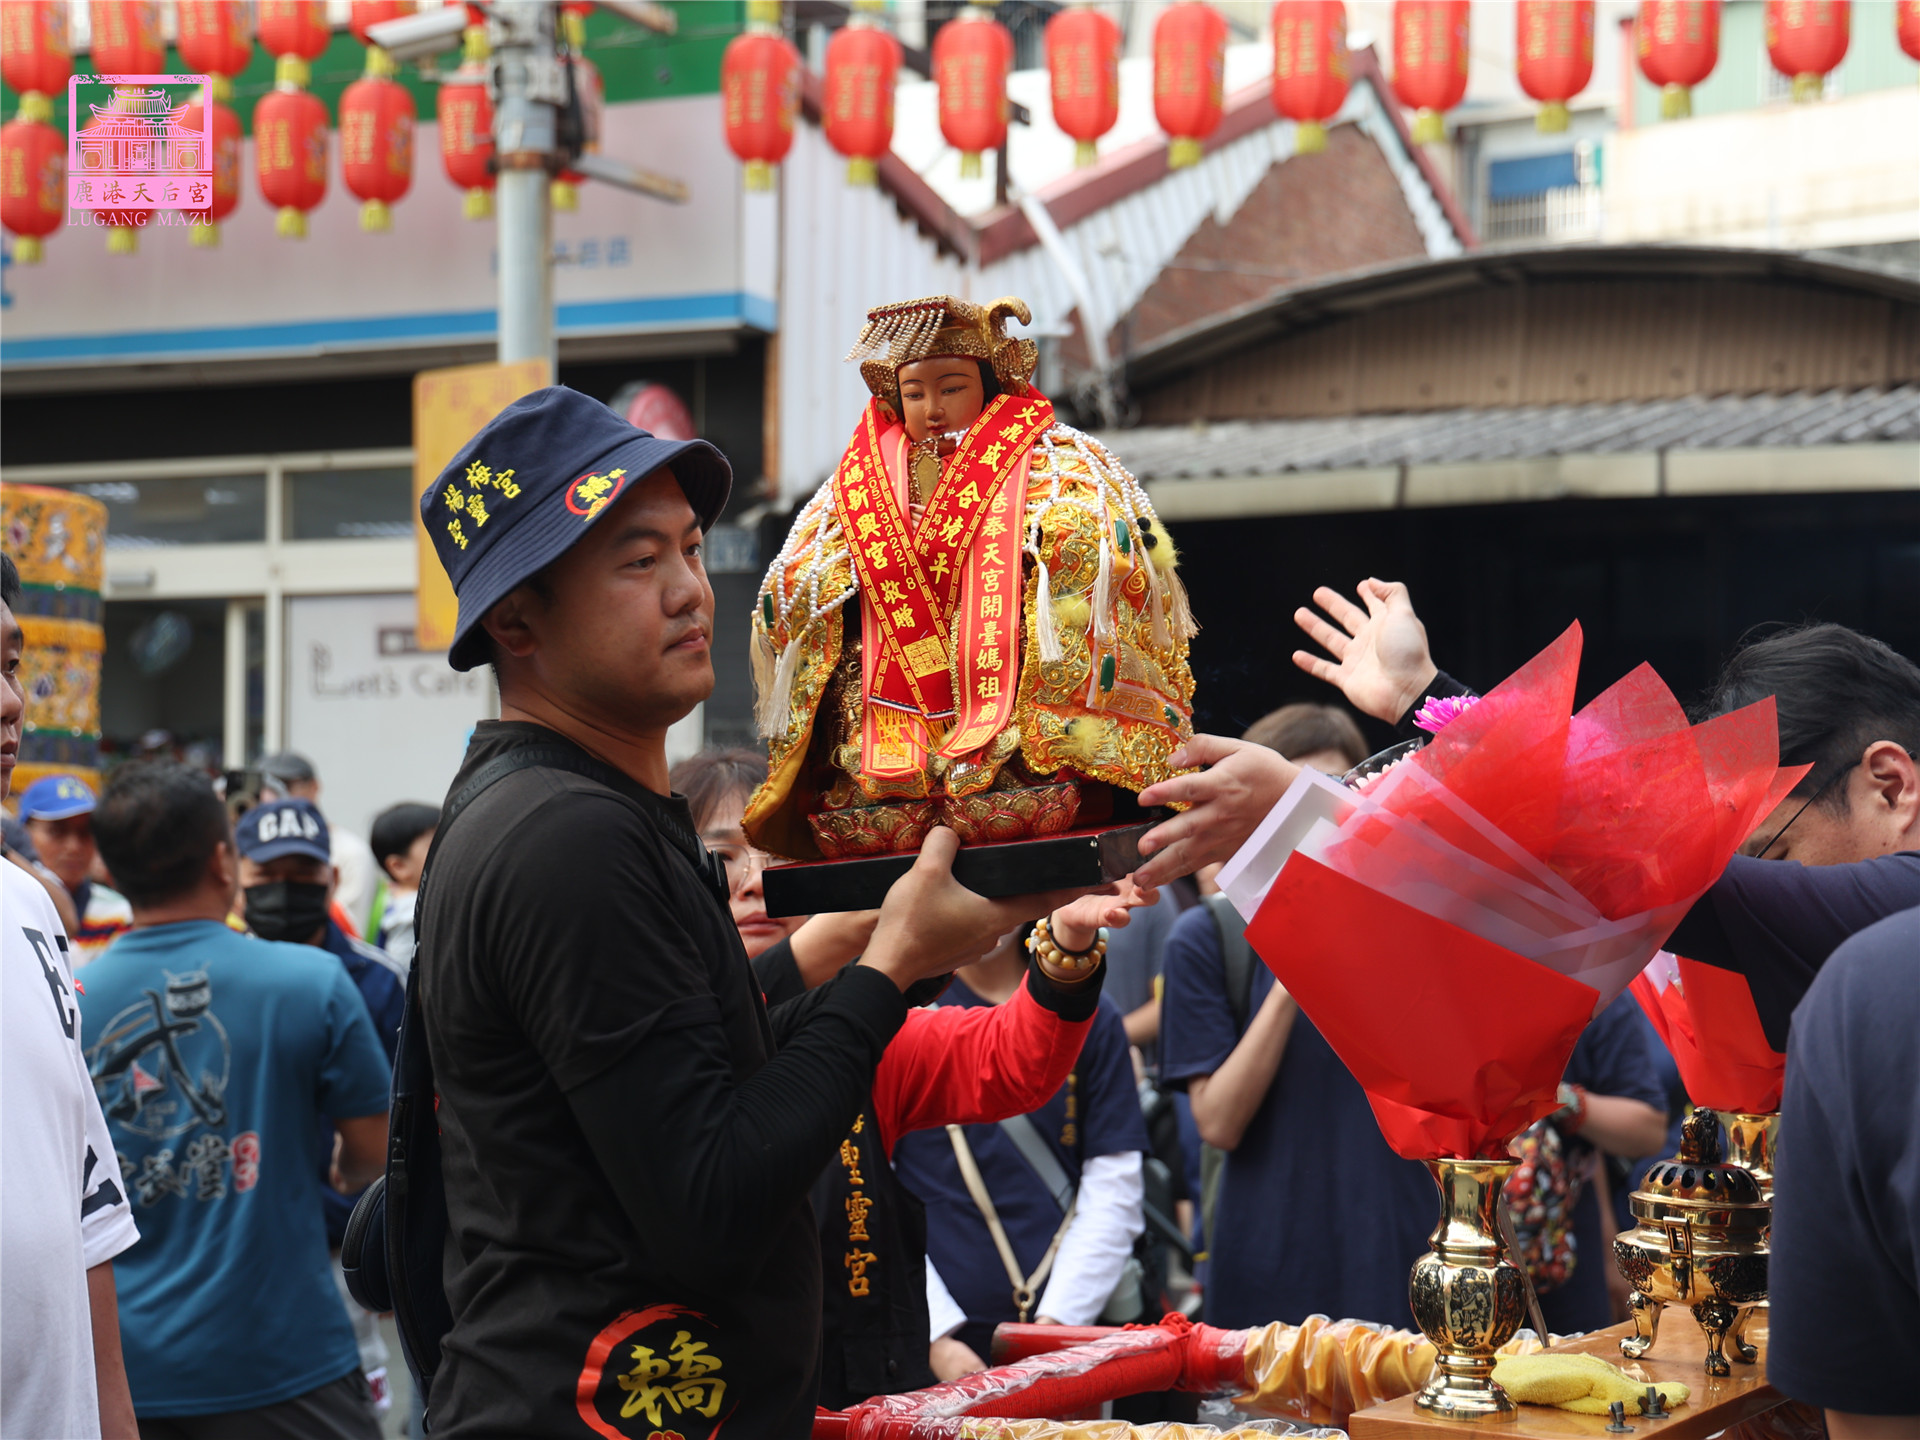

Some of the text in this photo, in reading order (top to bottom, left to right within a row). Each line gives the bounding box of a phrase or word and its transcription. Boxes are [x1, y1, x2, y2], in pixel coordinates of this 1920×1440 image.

[972, 475, 1009, 726] 港奉天宮開臺媽祖廟
[259, 808, 319, 842] GAP
